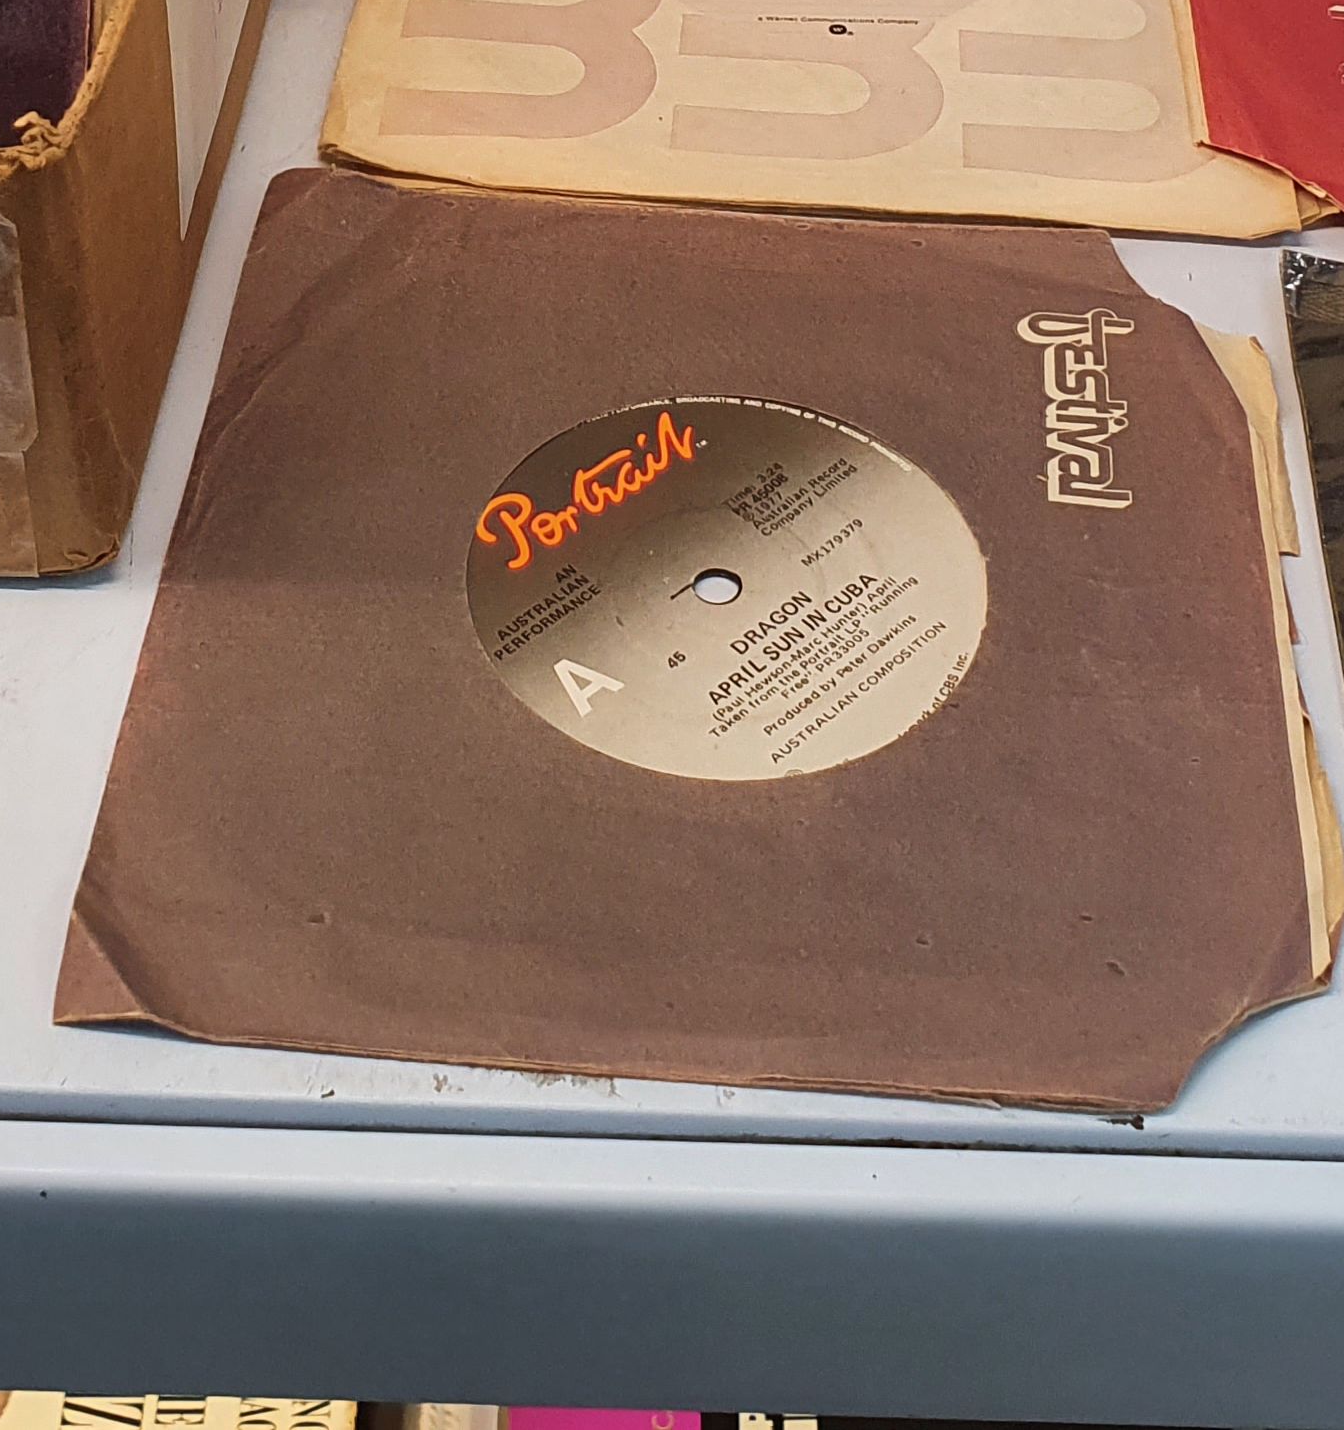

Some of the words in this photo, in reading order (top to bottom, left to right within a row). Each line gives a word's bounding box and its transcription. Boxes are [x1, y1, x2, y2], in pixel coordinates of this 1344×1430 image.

[477, 412, 694, 569] Portrait
[760, 494, 815, 541] Company
[813, 461, 858, 499] Limited
[808, 455, 848, 489] Record
[497, 575, 589, 642] AUSTRALIAN
[555, 564, 577, 584] AN
[865, 575, 898, 604] April
[494, 584, 602, 662] PERFORMANCE
[706, 654, 768, 707] APRIL
[762, 624, 805, 663] SUN
[802, 607, 828, 632] IN
[823, 568, 879, 617] CUBA
[729, 587, 813, 659] DRAGON
[554, 658, 624, 718] A
[665, 649, 688, 670] 45
[709, 705, 750, 740] Taken
[748, 683, 779, 710] from
[778, 667, 801, 687] the
[799, 632, 846, 671] Portrait
[763, 688, 821, 737] Produced
[819, 676, 838, 694] by
[836, 652, 868, 679] Peter
[867, 613, 918, 656] Dawkins
[769, 690, 860, 764] AUSTRALIAN
[857, 619, 948, 694] COMPOSITION
[939, 673, 959, 696] CBS
[952, 652, 969, 671] Inc.
